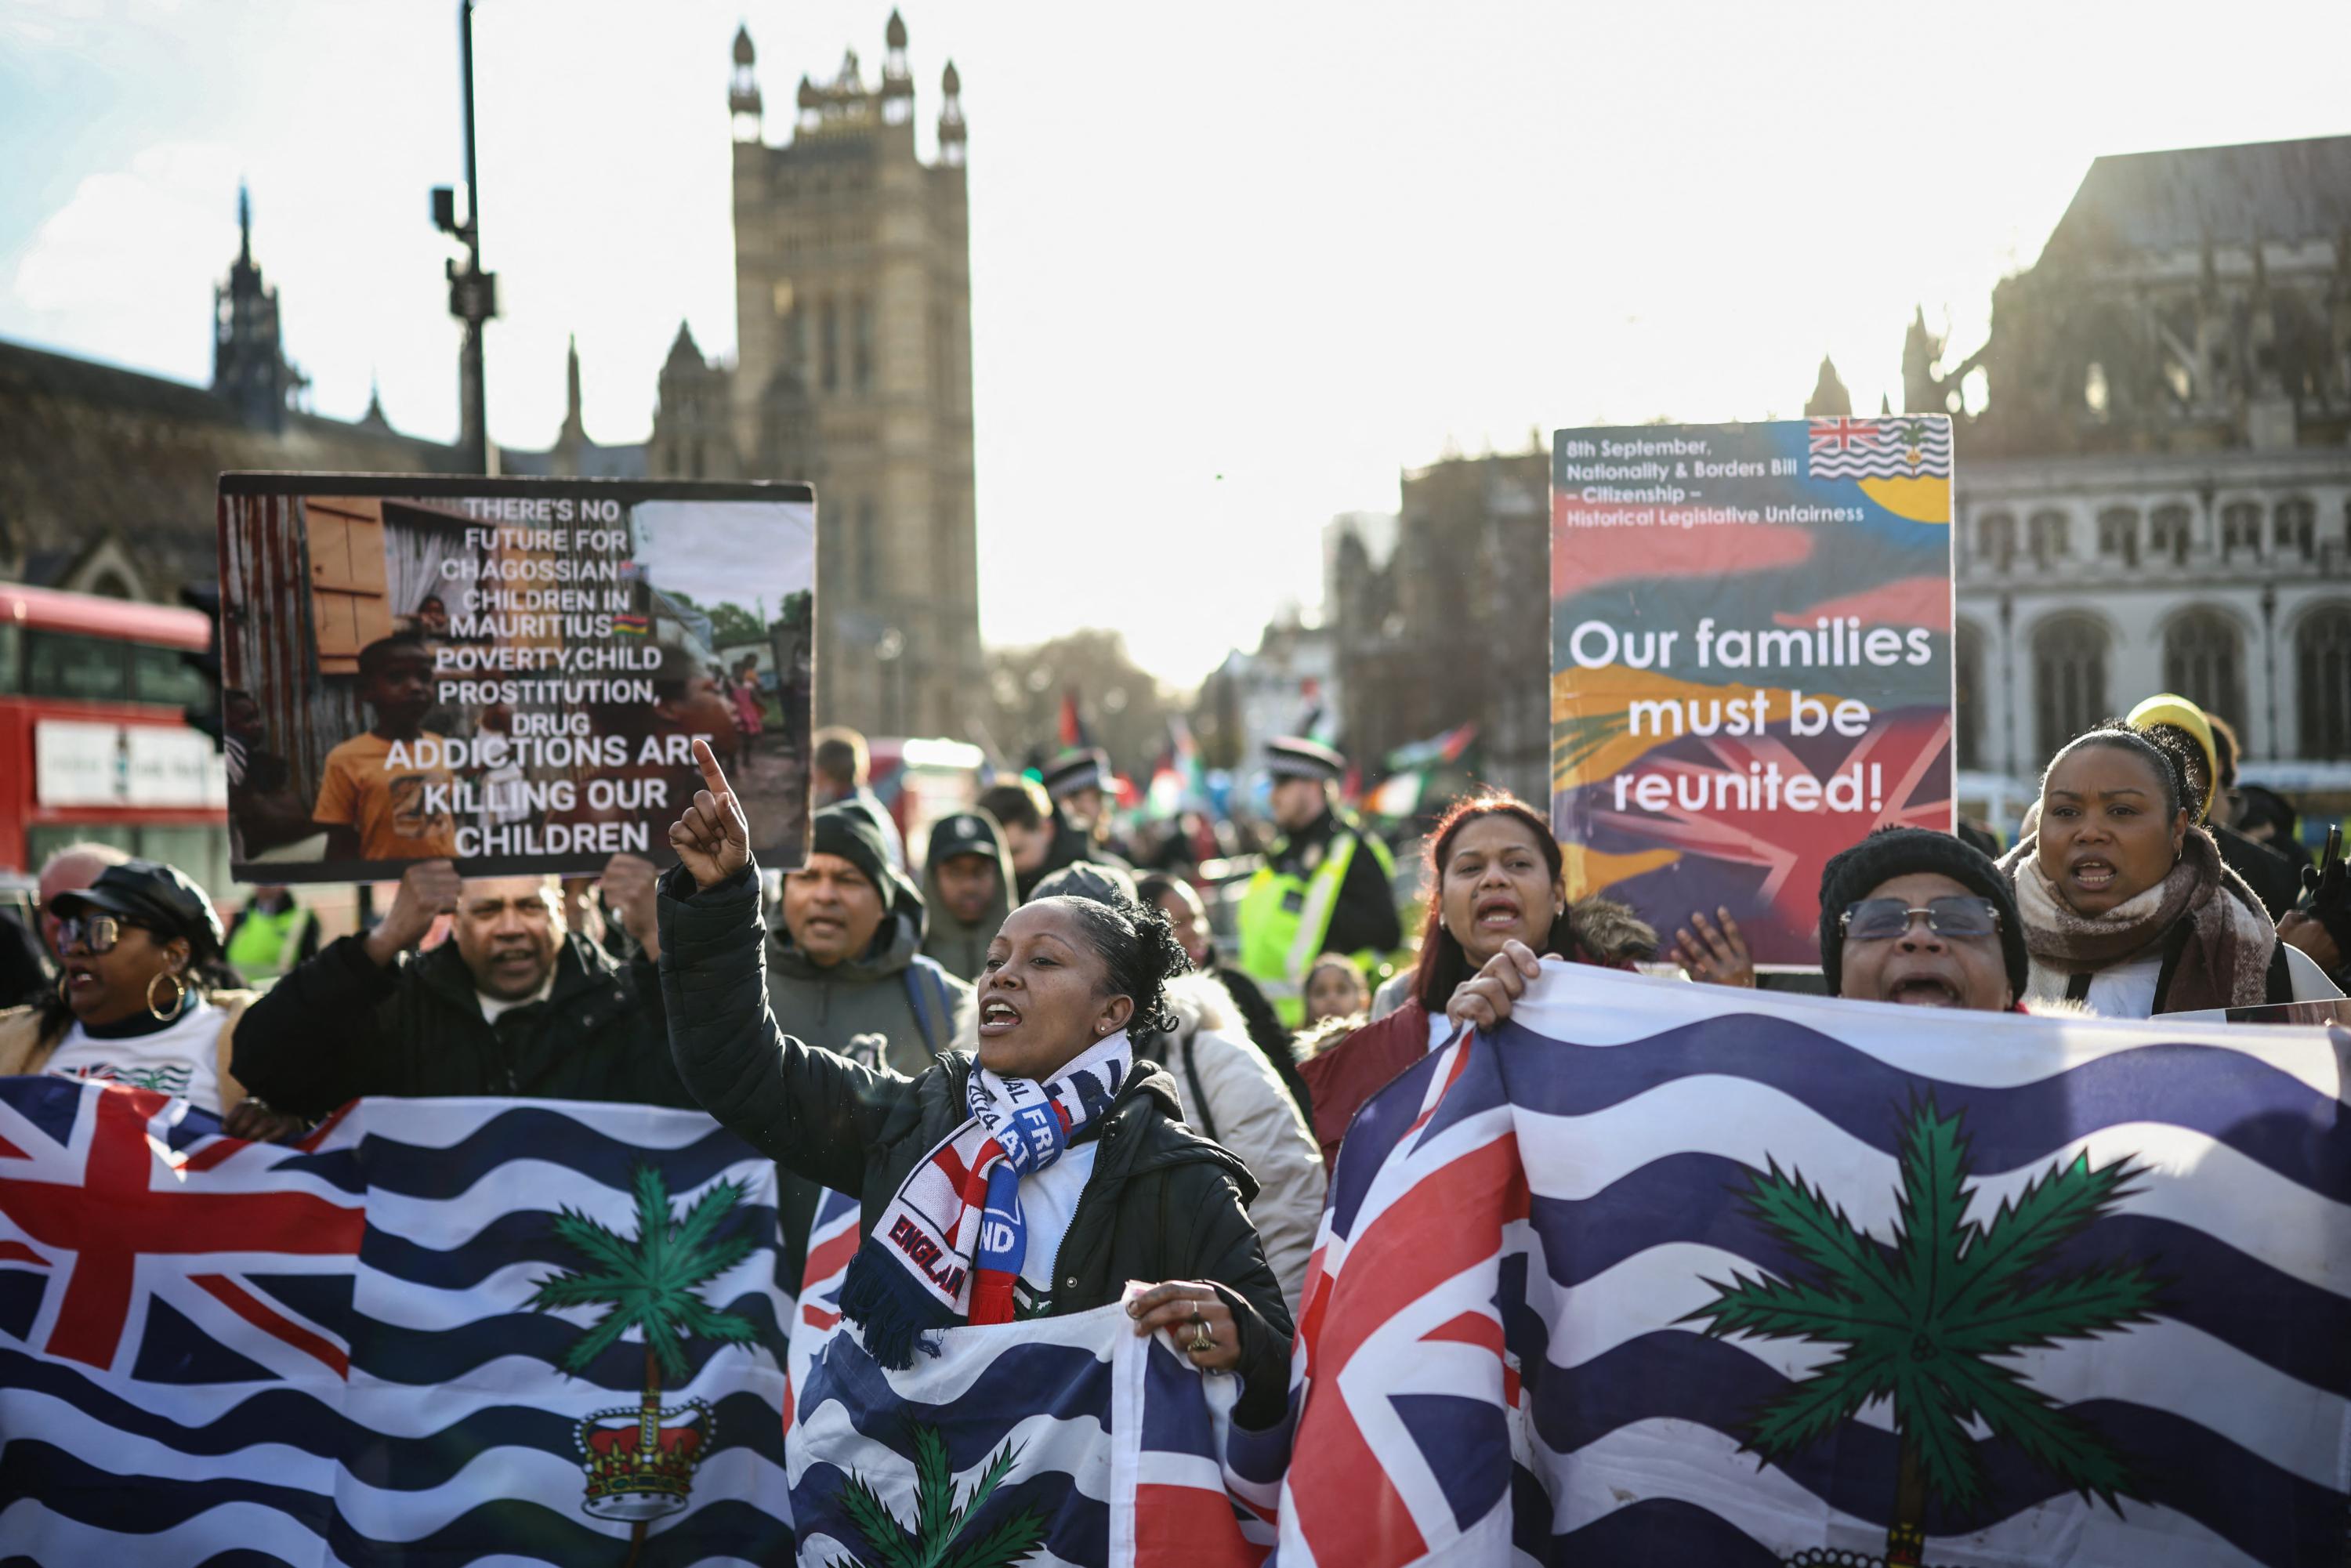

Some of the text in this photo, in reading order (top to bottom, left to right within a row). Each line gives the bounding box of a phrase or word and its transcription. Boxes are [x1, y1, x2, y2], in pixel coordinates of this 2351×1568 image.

[1567, 438, 1712, 460] 8th September,
[1567, 459, 1797, 483] Nationality & Borders Bill
[1582, 485, 1685, 505] Citizenship
[464, 498, 620, 522] THERE'S NO
[1567, 505, 1864, 529] Historical Legislative Unfairness
[465, 527, 628, 552] FUTURE FOR
[440, 558, 618, 581] CHAGOSSIAN
[462, 590, 631, 612] CHILDREN IN
[450, 614, 613, 639] MAURITIUS
[1570, 617, 1932, 669] Our families
[439, 679, 661, 706] PROSTITUTION,
[512, 712, 591, 737] DRUG
[1628, 690, 1871, 737] must be
[384, 735, 627, 770] ADDICTIONS
[425, 778, 668, 815] KILLING OUR
[1614, 762, 1882, 813] reunited!
[455, 821, 649, 858] CHILDREN
[1000, 1077, 1030, 1104] AL
